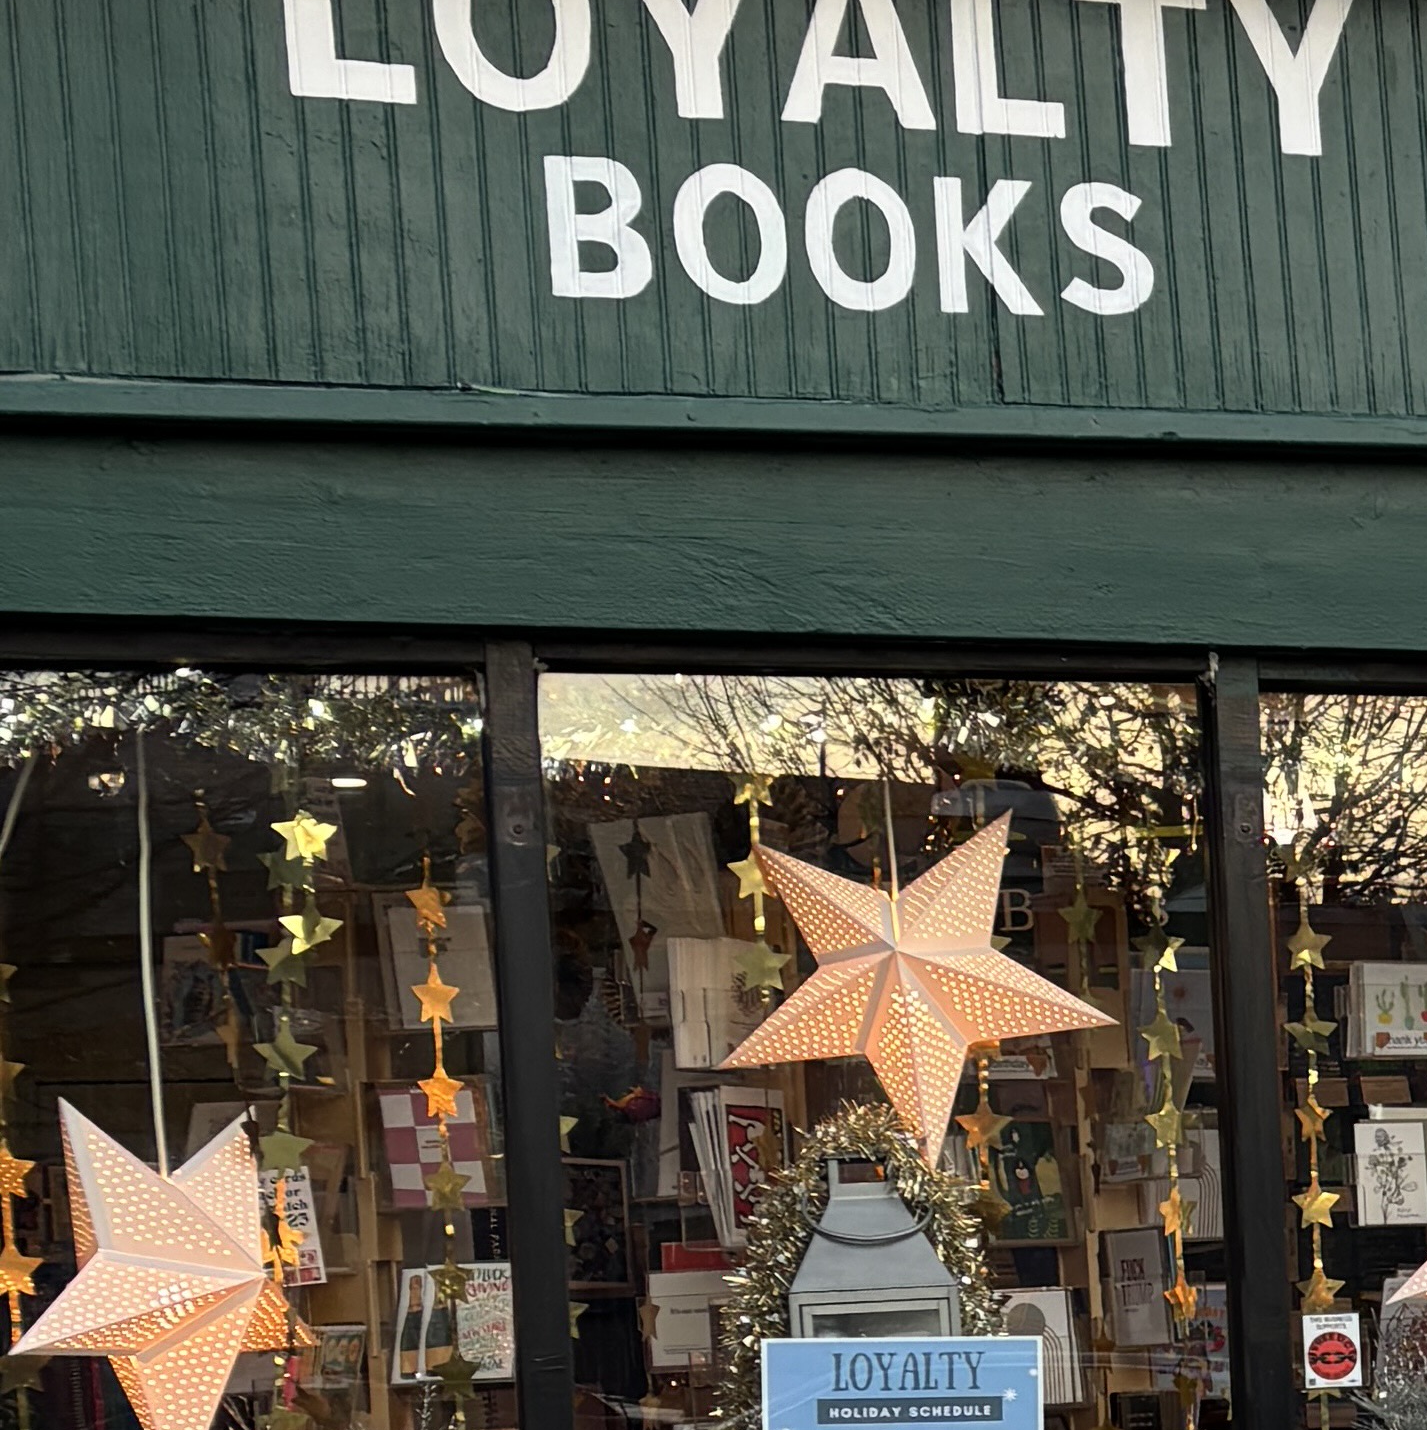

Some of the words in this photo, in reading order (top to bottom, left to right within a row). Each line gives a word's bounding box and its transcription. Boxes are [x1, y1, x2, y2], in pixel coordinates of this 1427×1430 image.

[543, 154, 1156, 316] BOOKS
[832, 1350, 986, 1392] LOYALTY
[829, 1407, 902, 1419] HOLIDAY
[908, 1404, 992, 1418] SCHEDULE
